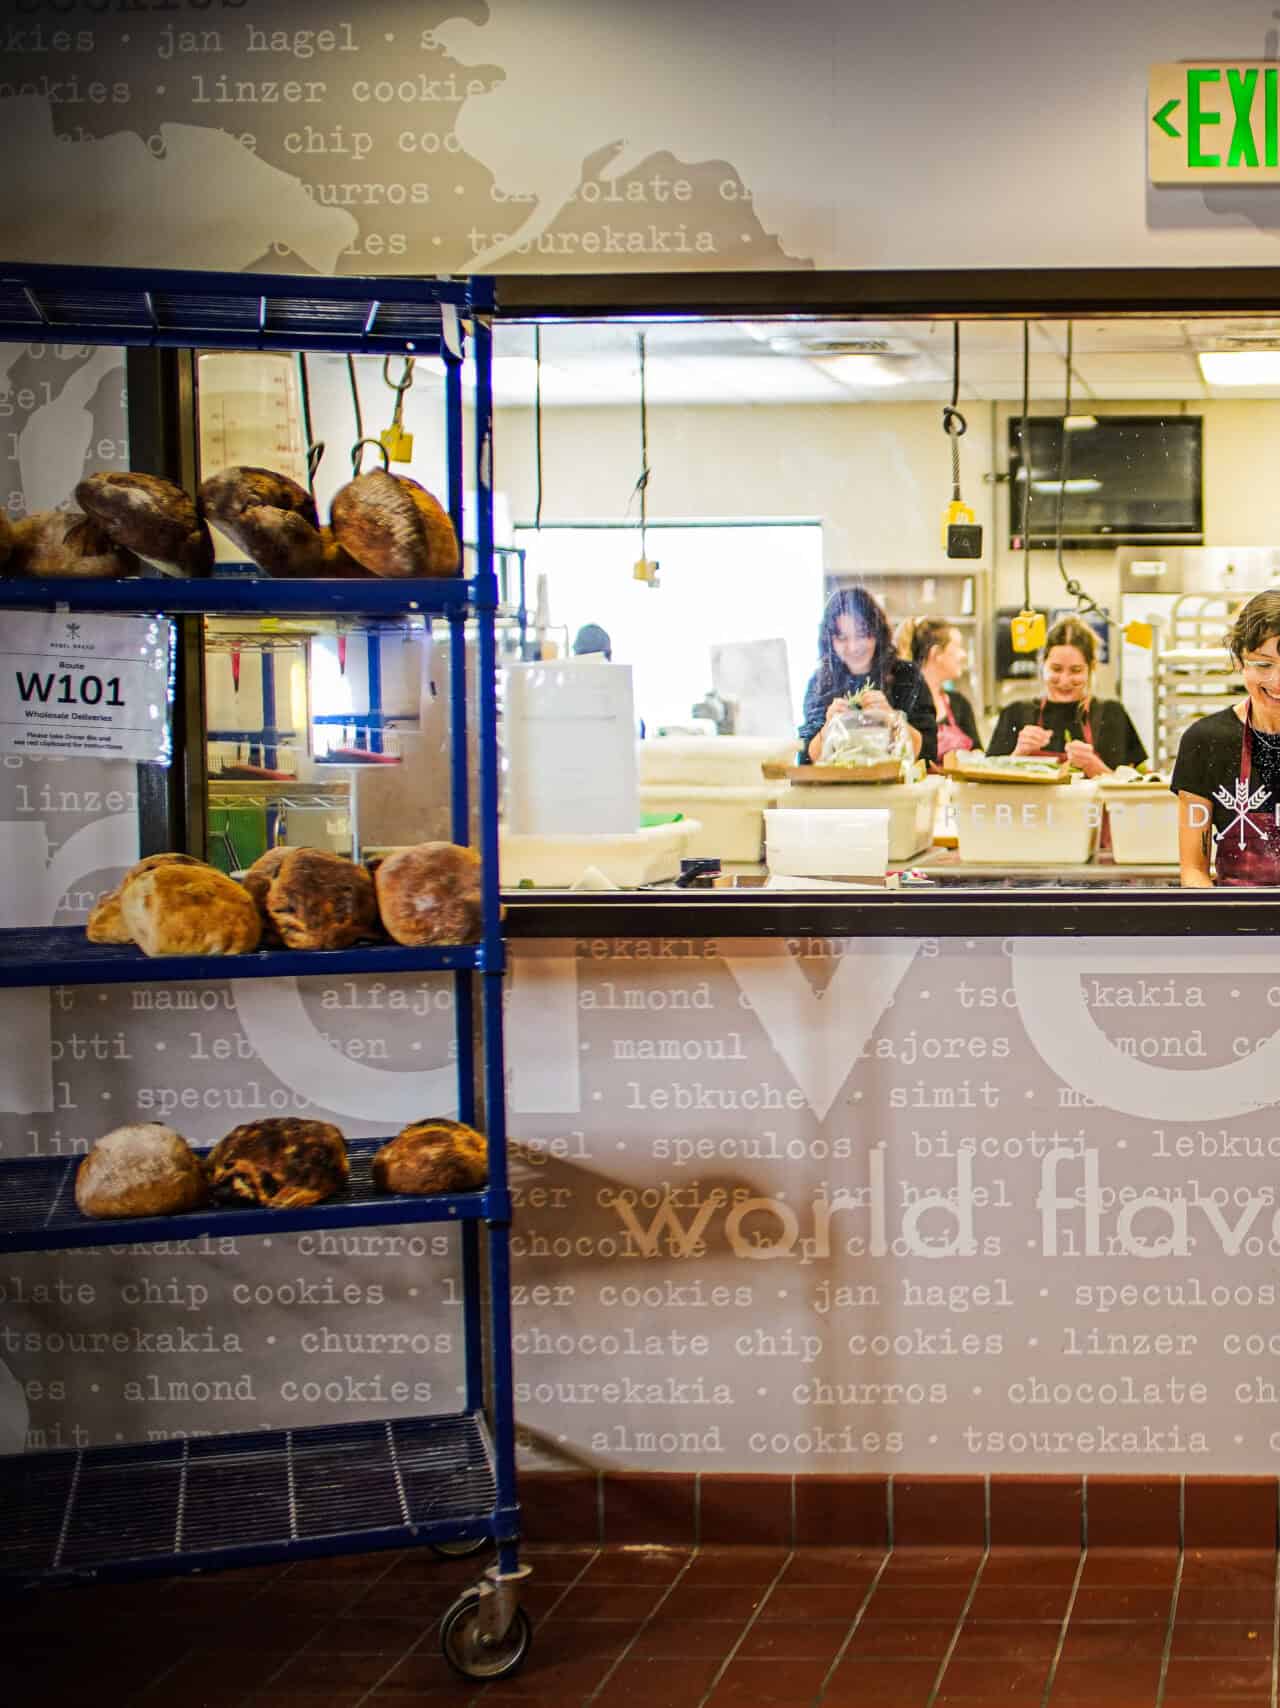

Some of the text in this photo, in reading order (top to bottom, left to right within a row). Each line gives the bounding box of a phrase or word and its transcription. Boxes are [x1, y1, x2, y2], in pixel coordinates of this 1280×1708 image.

[158, 24, 223, 58] jan
[246, 24, 358, 58] hagel
[191, 76, 327, 103] linzer
[284, 126, 373, 159] chip
[16, 671, 125, 707] W101
[945, 803, 1058, 828] REBEL
[131, 986, 239, 1011] mamou
[579, 982, 716, 1009] almond
[612, 1033, 748, 1060] mamoul
[136, 1081, 311, 1116] speculoo
[626, 1081, 807, 1110] lebkuche
[889, 1080, 1001, 1109] simit
[652, 1132, 852, 1166] speculoos
[911, 1130, 1088, 1158] biscotti
[596, 1181, 750, 1209] cookies
[613, 1146, 972, 1259] world
[298, 1231, 450, 1257] churros
[121, 1276, 209, 1311] chip
[232, 1276, 385, 1305] cookies
[599, 1279, 753, 1307] cookies
[814, 1279, 880, 1312] jan
[903, 1278, 1015, 1312] hagel
[1074, 1279, 1276, 1312] speculoos
[2, 1326, 244, 1353] tsourekakia
[301, 1326, 453, 1355] churros
[511, 1327, 710, 1357] chocolate
[735, 1328, 824, 1363] chip
[848, 1328, 1004, 1356] cookies
[1063, 1327, 1199, 1356] linzer
[123, 1375, 257, 1402] almond
[280, 1374, 433, 1402] cookies
[513, 1376, 736, 1406] sourekakia
[792, 1378, 949, 1406] churros
[1007, 1376, 1209, 1405] chocolate
[591, 1425, 726, 1454] almond
[749, 1424, 906, 1454] cookies
[964, 1425, 1211, 1454] tsourekakia
